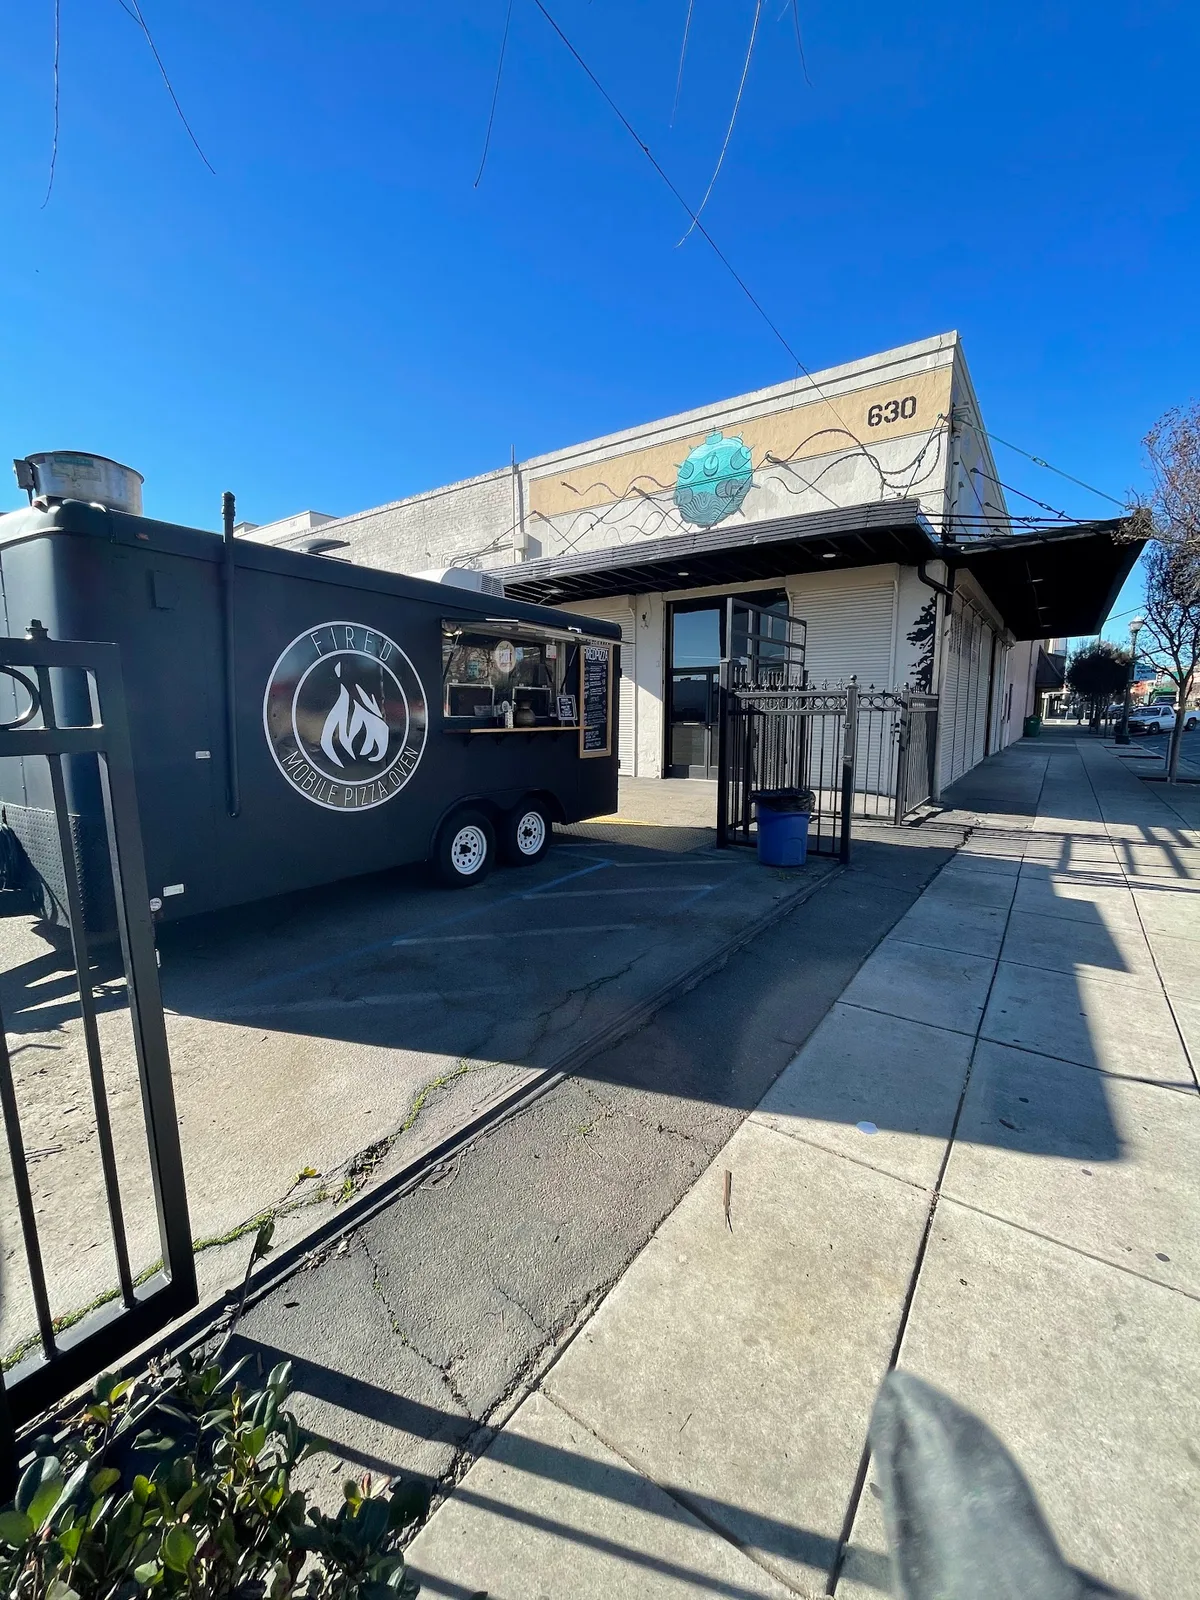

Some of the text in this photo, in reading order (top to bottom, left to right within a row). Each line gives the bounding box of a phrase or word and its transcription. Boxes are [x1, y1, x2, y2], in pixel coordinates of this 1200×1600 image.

[868, 396, 917, 427] 630
[310, 626, 394, 662] FIRED
[281, 745, 420, 807] MOBILE PIZZA OVEN
